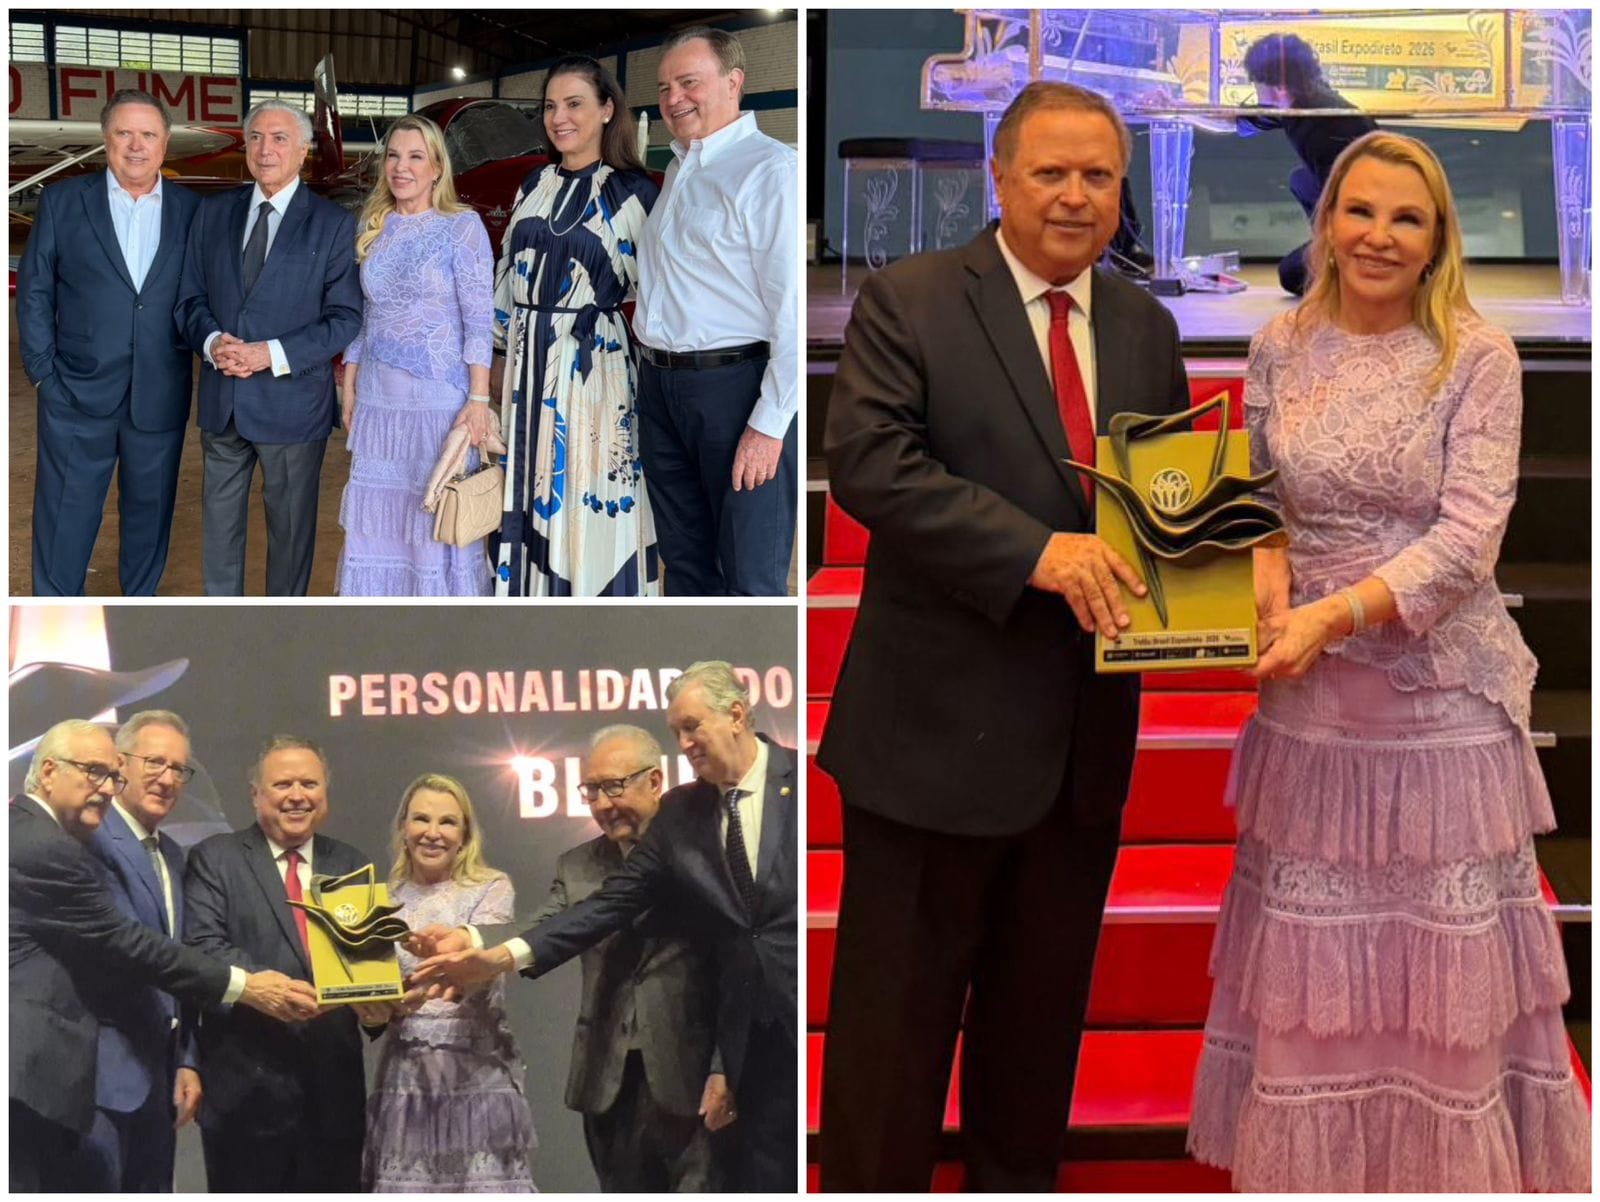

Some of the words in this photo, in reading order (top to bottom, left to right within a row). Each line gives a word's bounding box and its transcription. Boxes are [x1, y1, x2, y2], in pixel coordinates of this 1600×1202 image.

[1311, 40, 1338, 54] rasil
[1341, 39, 1403, 58] Expodireto
[1408, 41, 1435, 56] 2026
